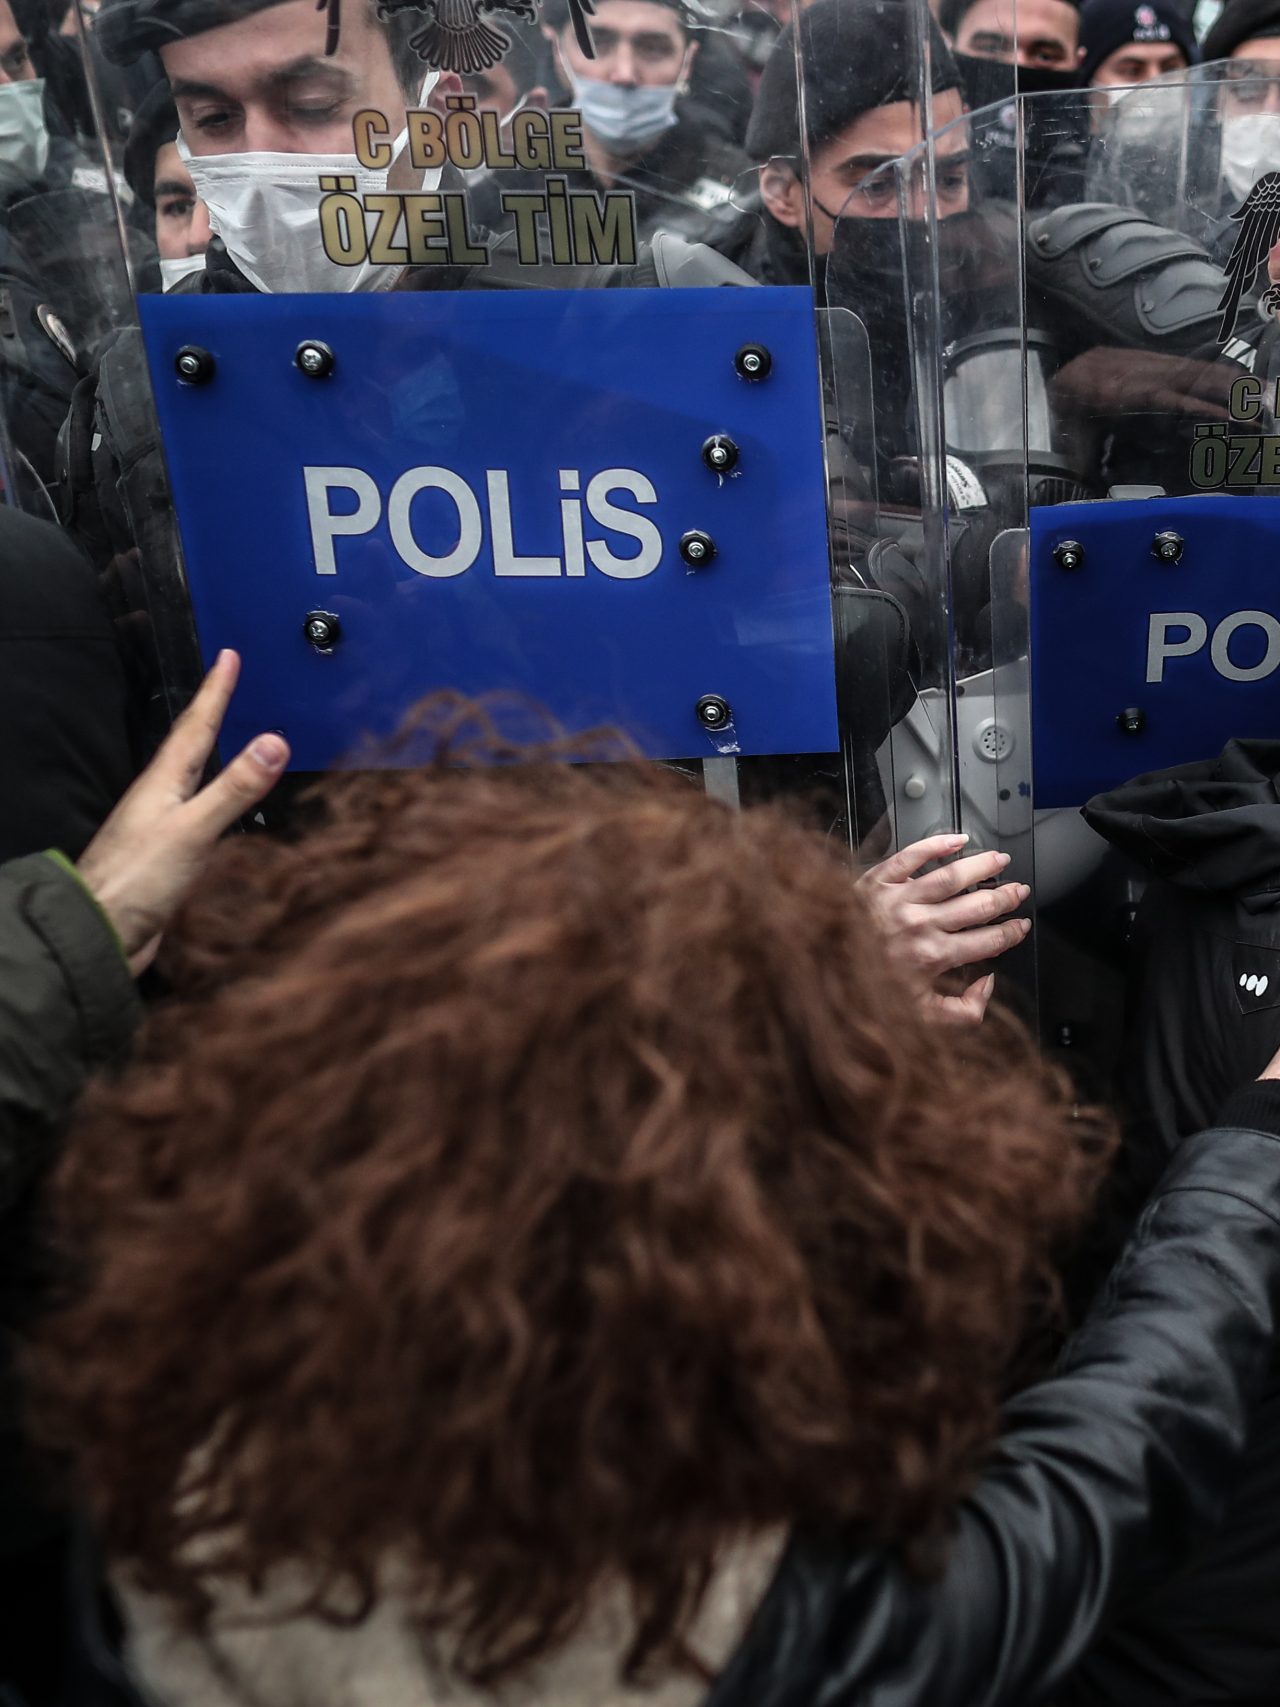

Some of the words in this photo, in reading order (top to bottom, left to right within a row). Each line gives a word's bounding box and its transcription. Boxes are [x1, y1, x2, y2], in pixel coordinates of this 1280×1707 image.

[353, 109, 393, 171] C
[407, 96, 586, 170] BÖLGE
[319, 176, 489, 267] ÖZEL
[502, 177, 637, 267] TİM
[1229, 378, 1262, 420] C
